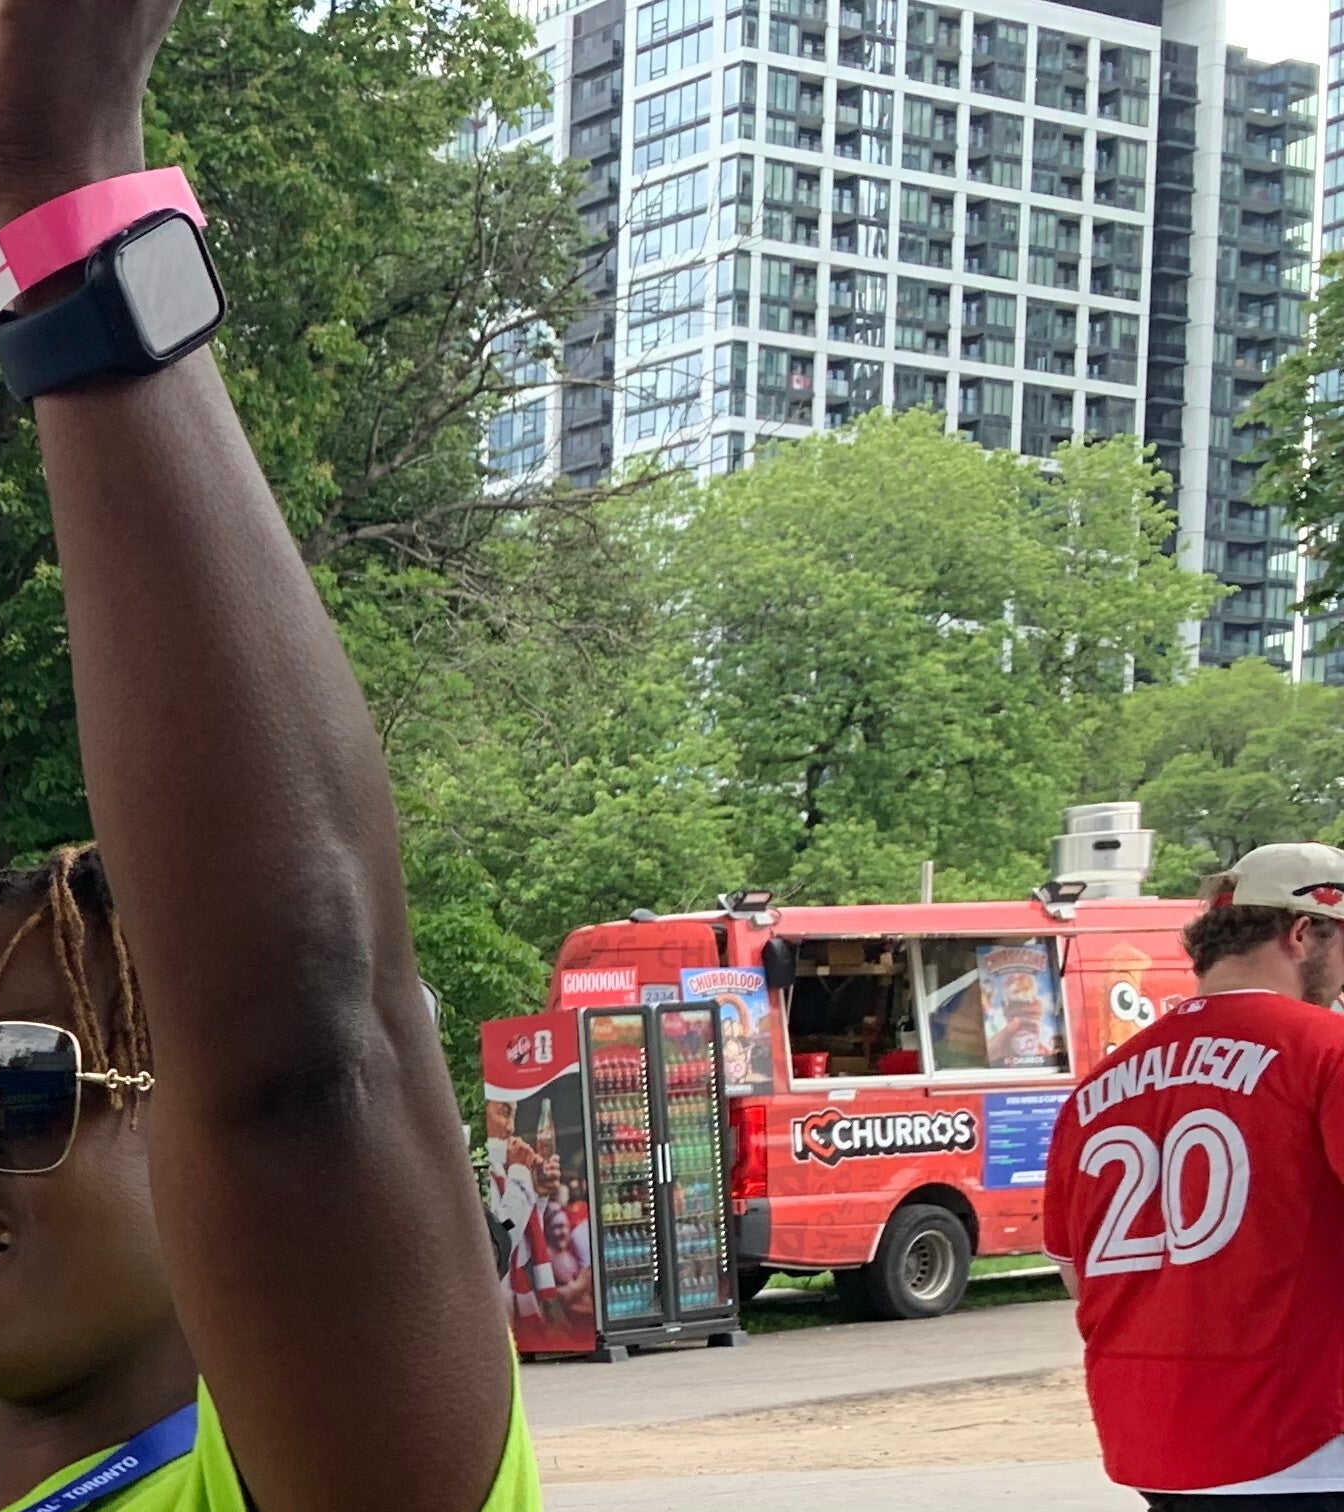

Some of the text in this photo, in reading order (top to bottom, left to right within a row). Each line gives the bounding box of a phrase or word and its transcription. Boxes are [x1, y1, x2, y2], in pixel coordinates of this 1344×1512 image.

[688, 970, 763, 995] CHURROLOOP
[1076, 1036, 1279, 1127] DONALDSON
[830, 1112, 973, 1151] CHURROS
[1078, 1108, 1251, 1278] 20
[62, 1455, 140, 1501] TORONTO
